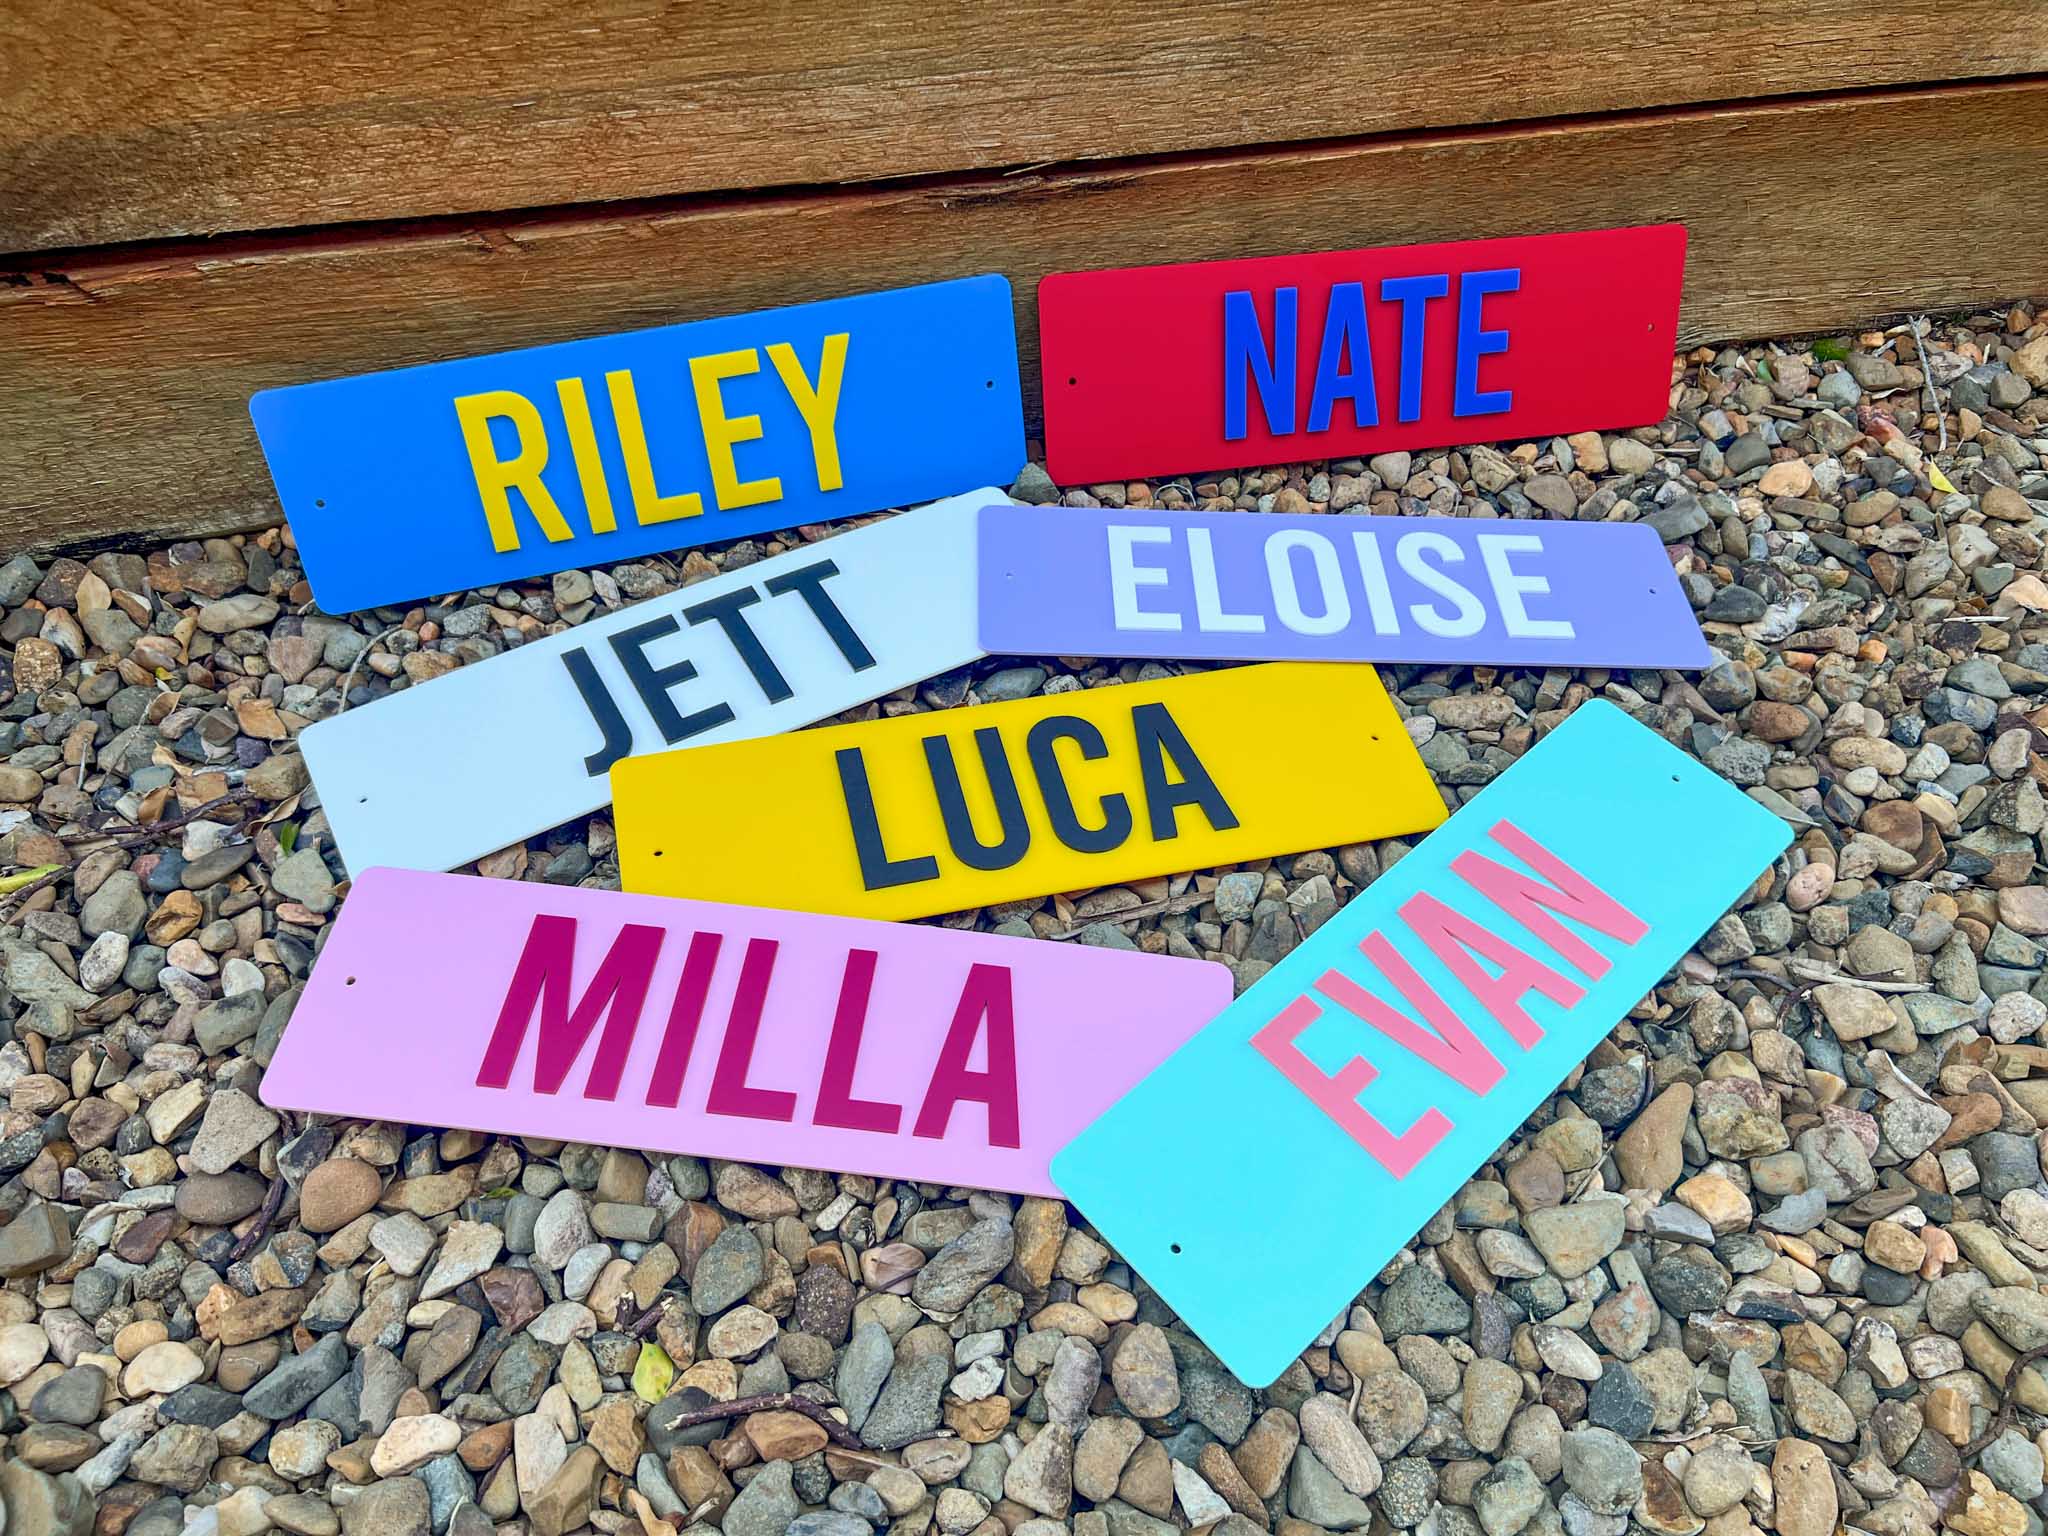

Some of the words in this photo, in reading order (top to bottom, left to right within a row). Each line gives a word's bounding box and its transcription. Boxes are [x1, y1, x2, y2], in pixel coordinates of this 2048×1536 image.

[453, 332, 850, 553] RILEY
[1223, 268, 1521, 440] NATE
[560, 558, 877, 777] JETT
[1106, 524, 1576, 640] ELOISE
[835, 702, 1238, 891] LUCA
[476, 913, 1020, 1149] MILLA
[1250, 818, 1650, 1180] EVAN
